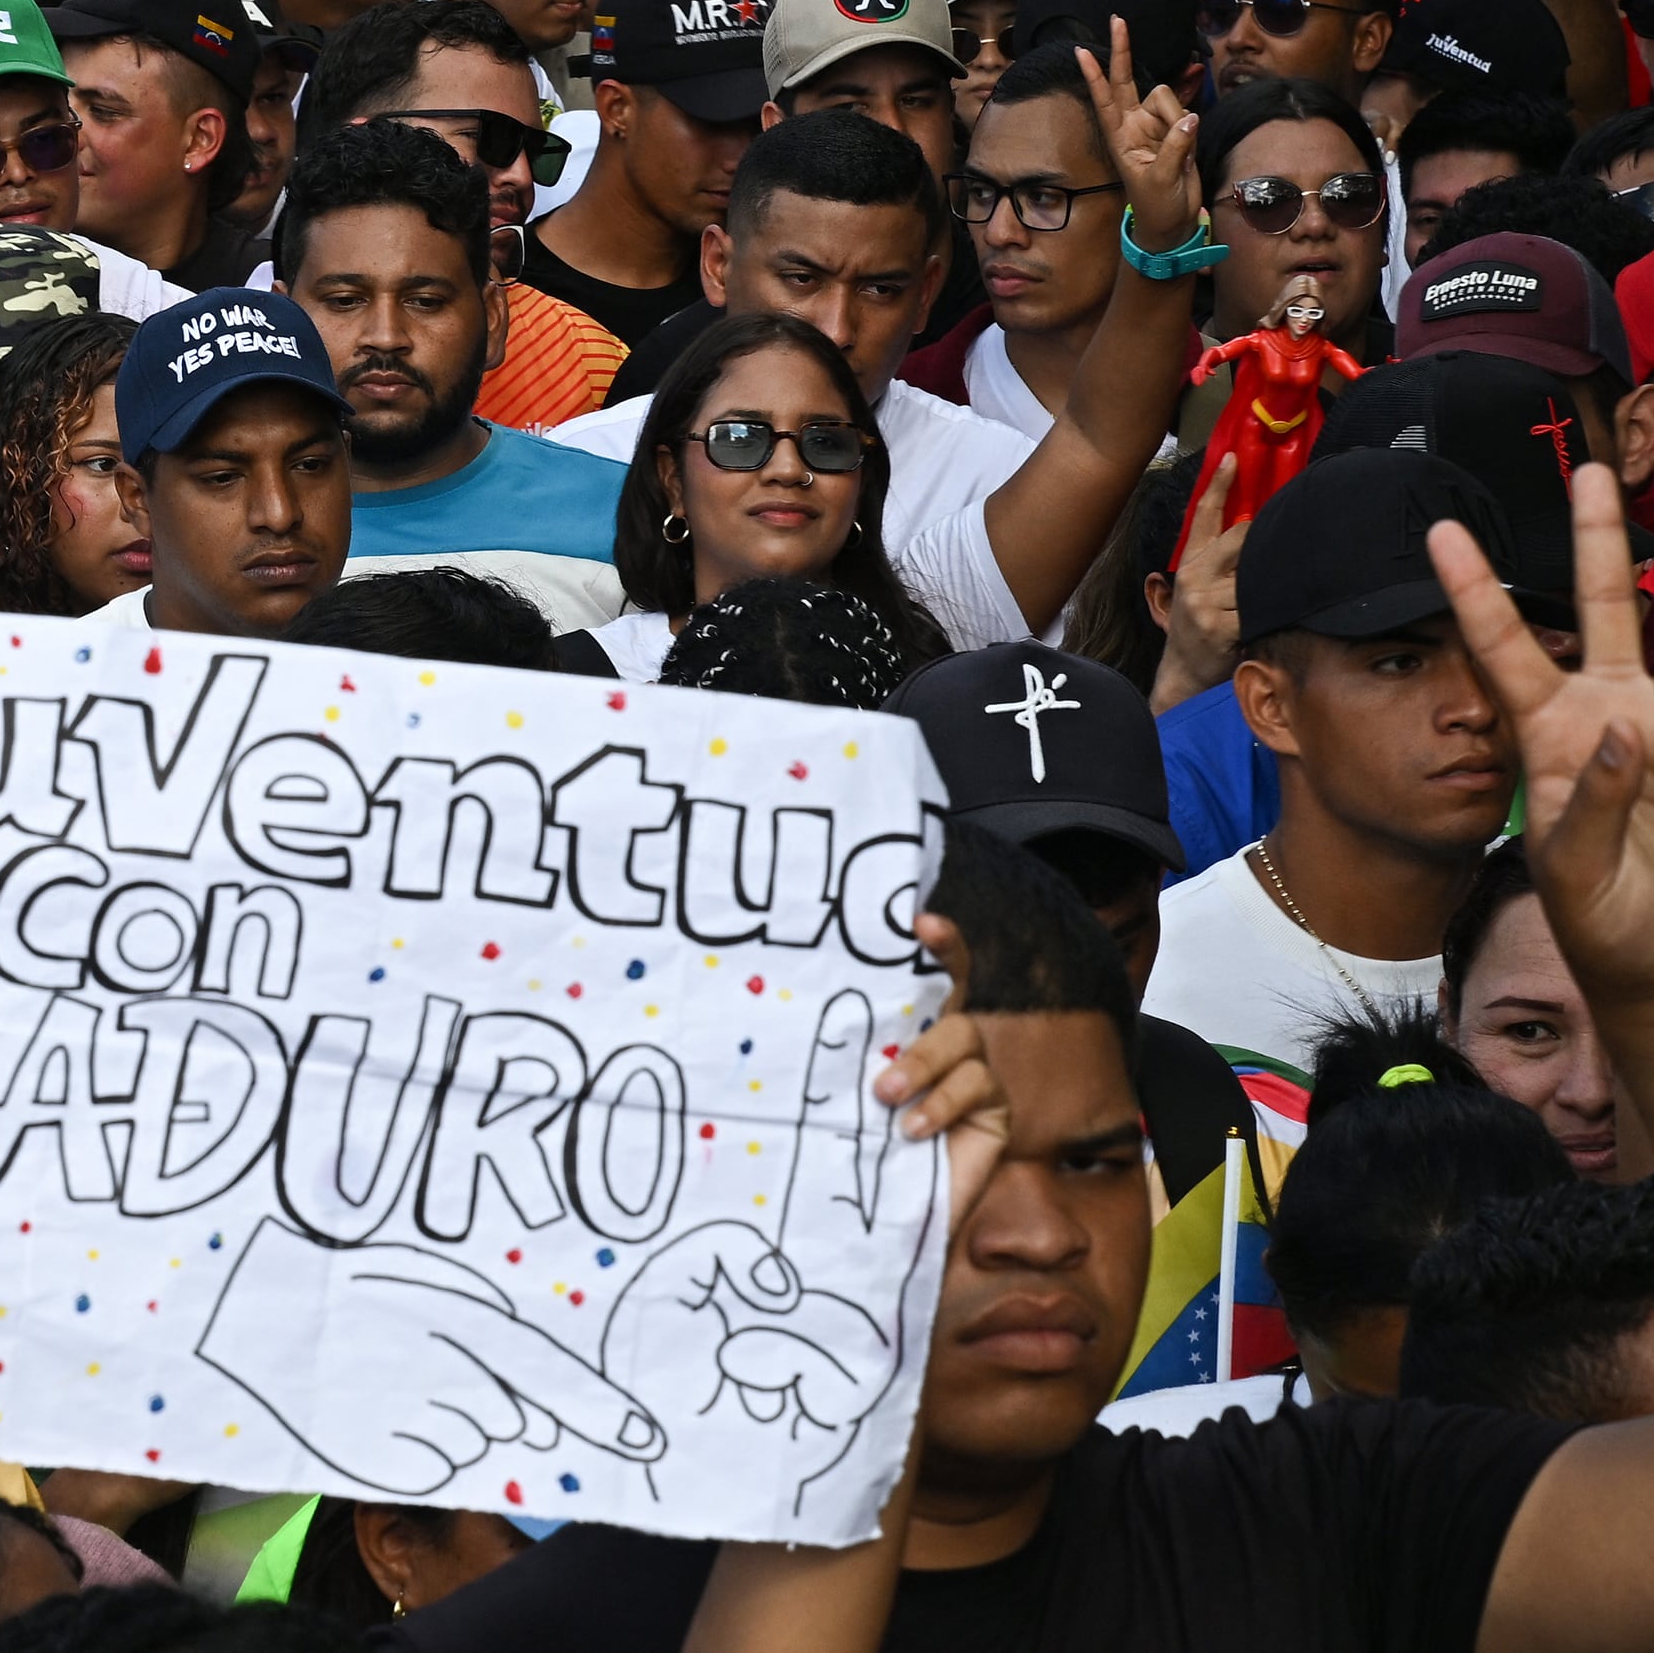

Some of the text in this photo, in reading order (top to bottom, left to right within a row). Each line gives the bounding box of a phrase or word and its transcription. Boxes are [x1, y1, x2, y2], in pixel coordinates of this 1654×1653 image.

[1424, 270, 1539, 302] Ernesto Luna
[181, 303, 276, 344] NO WAR
[167, 332, 301, 384] YES PEACE!
